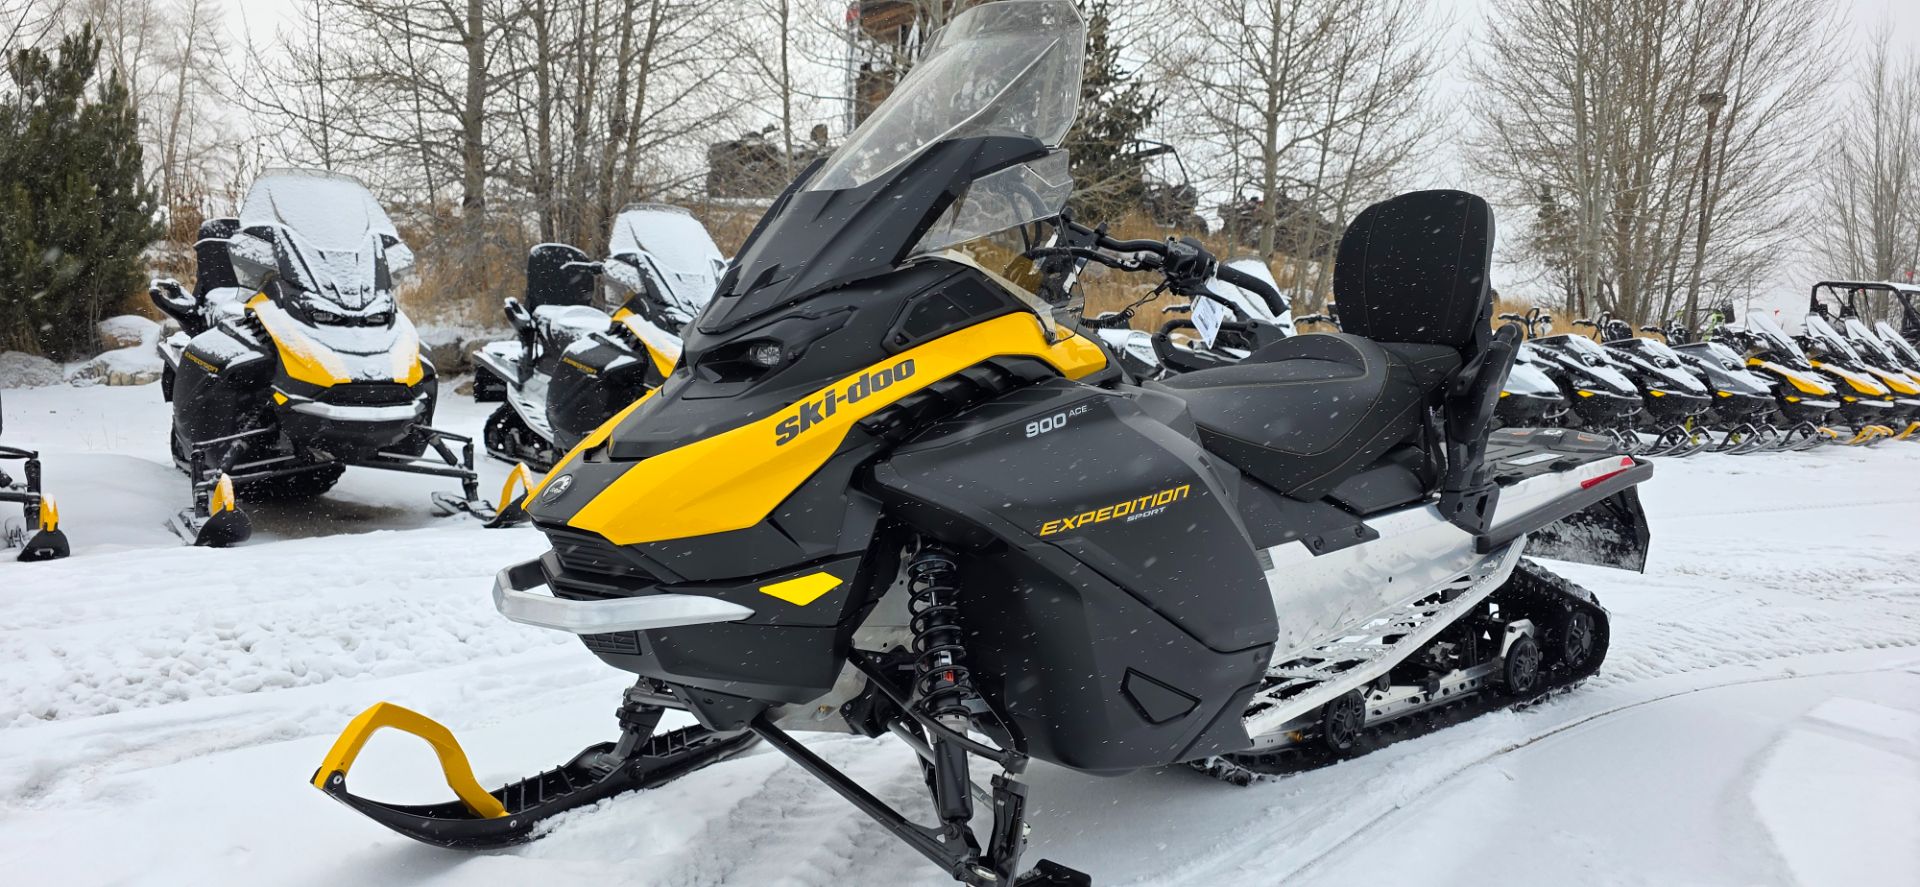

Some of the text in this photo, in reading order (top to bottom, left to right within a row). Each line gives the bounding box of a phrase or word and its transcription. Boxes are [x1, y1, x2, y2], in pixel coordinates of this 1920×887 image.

[1025, 404, 1088, 438] 900 ACE
[1039, 484, 1191, 537] EXPEDITION
[1126, 506, 1167, 523] SPORT
